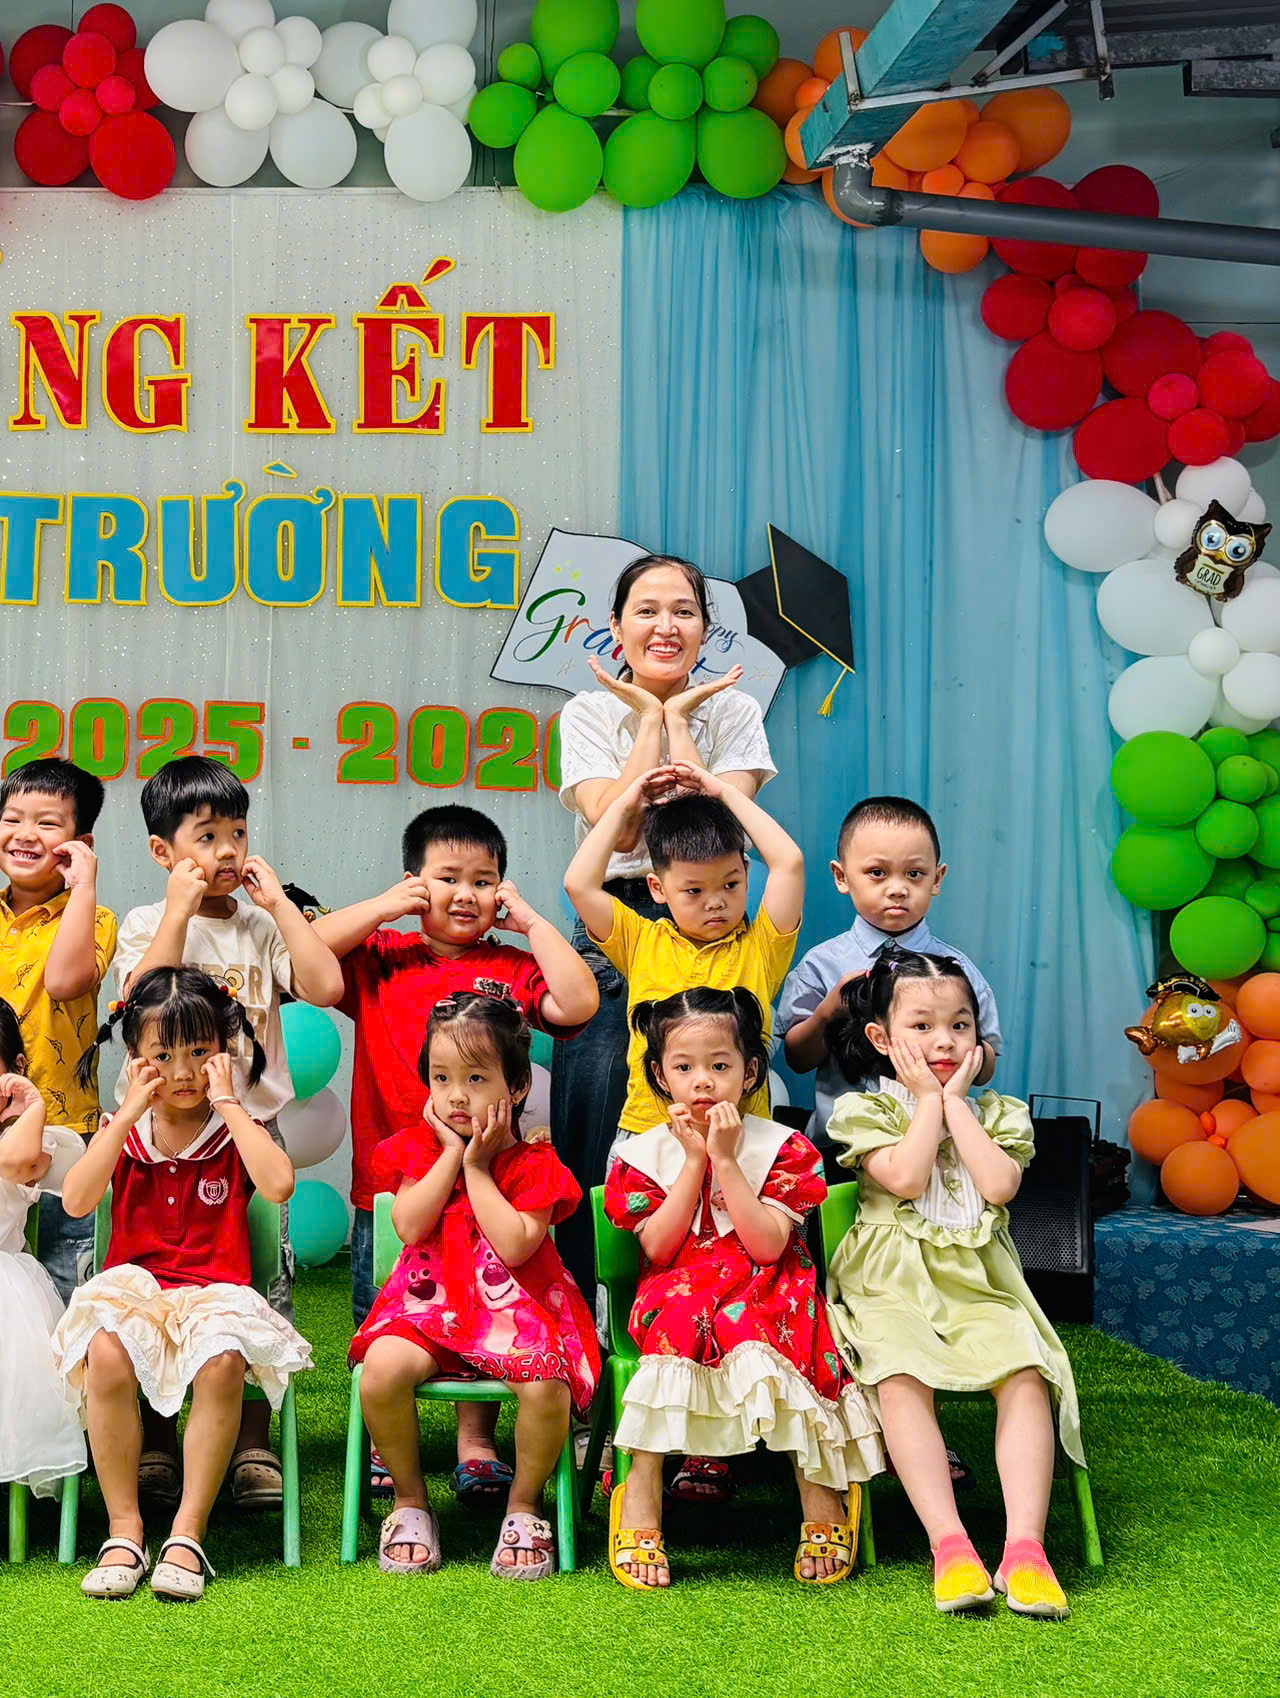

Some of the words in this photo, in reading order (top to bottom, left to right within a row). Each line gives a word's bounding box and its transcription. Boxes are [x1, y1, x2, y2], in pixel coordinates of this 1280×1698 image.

[243, 256, 556, 436] KẾT
[0, 697, 266, 784] 2025
[336, 701, 564, 793] 202
